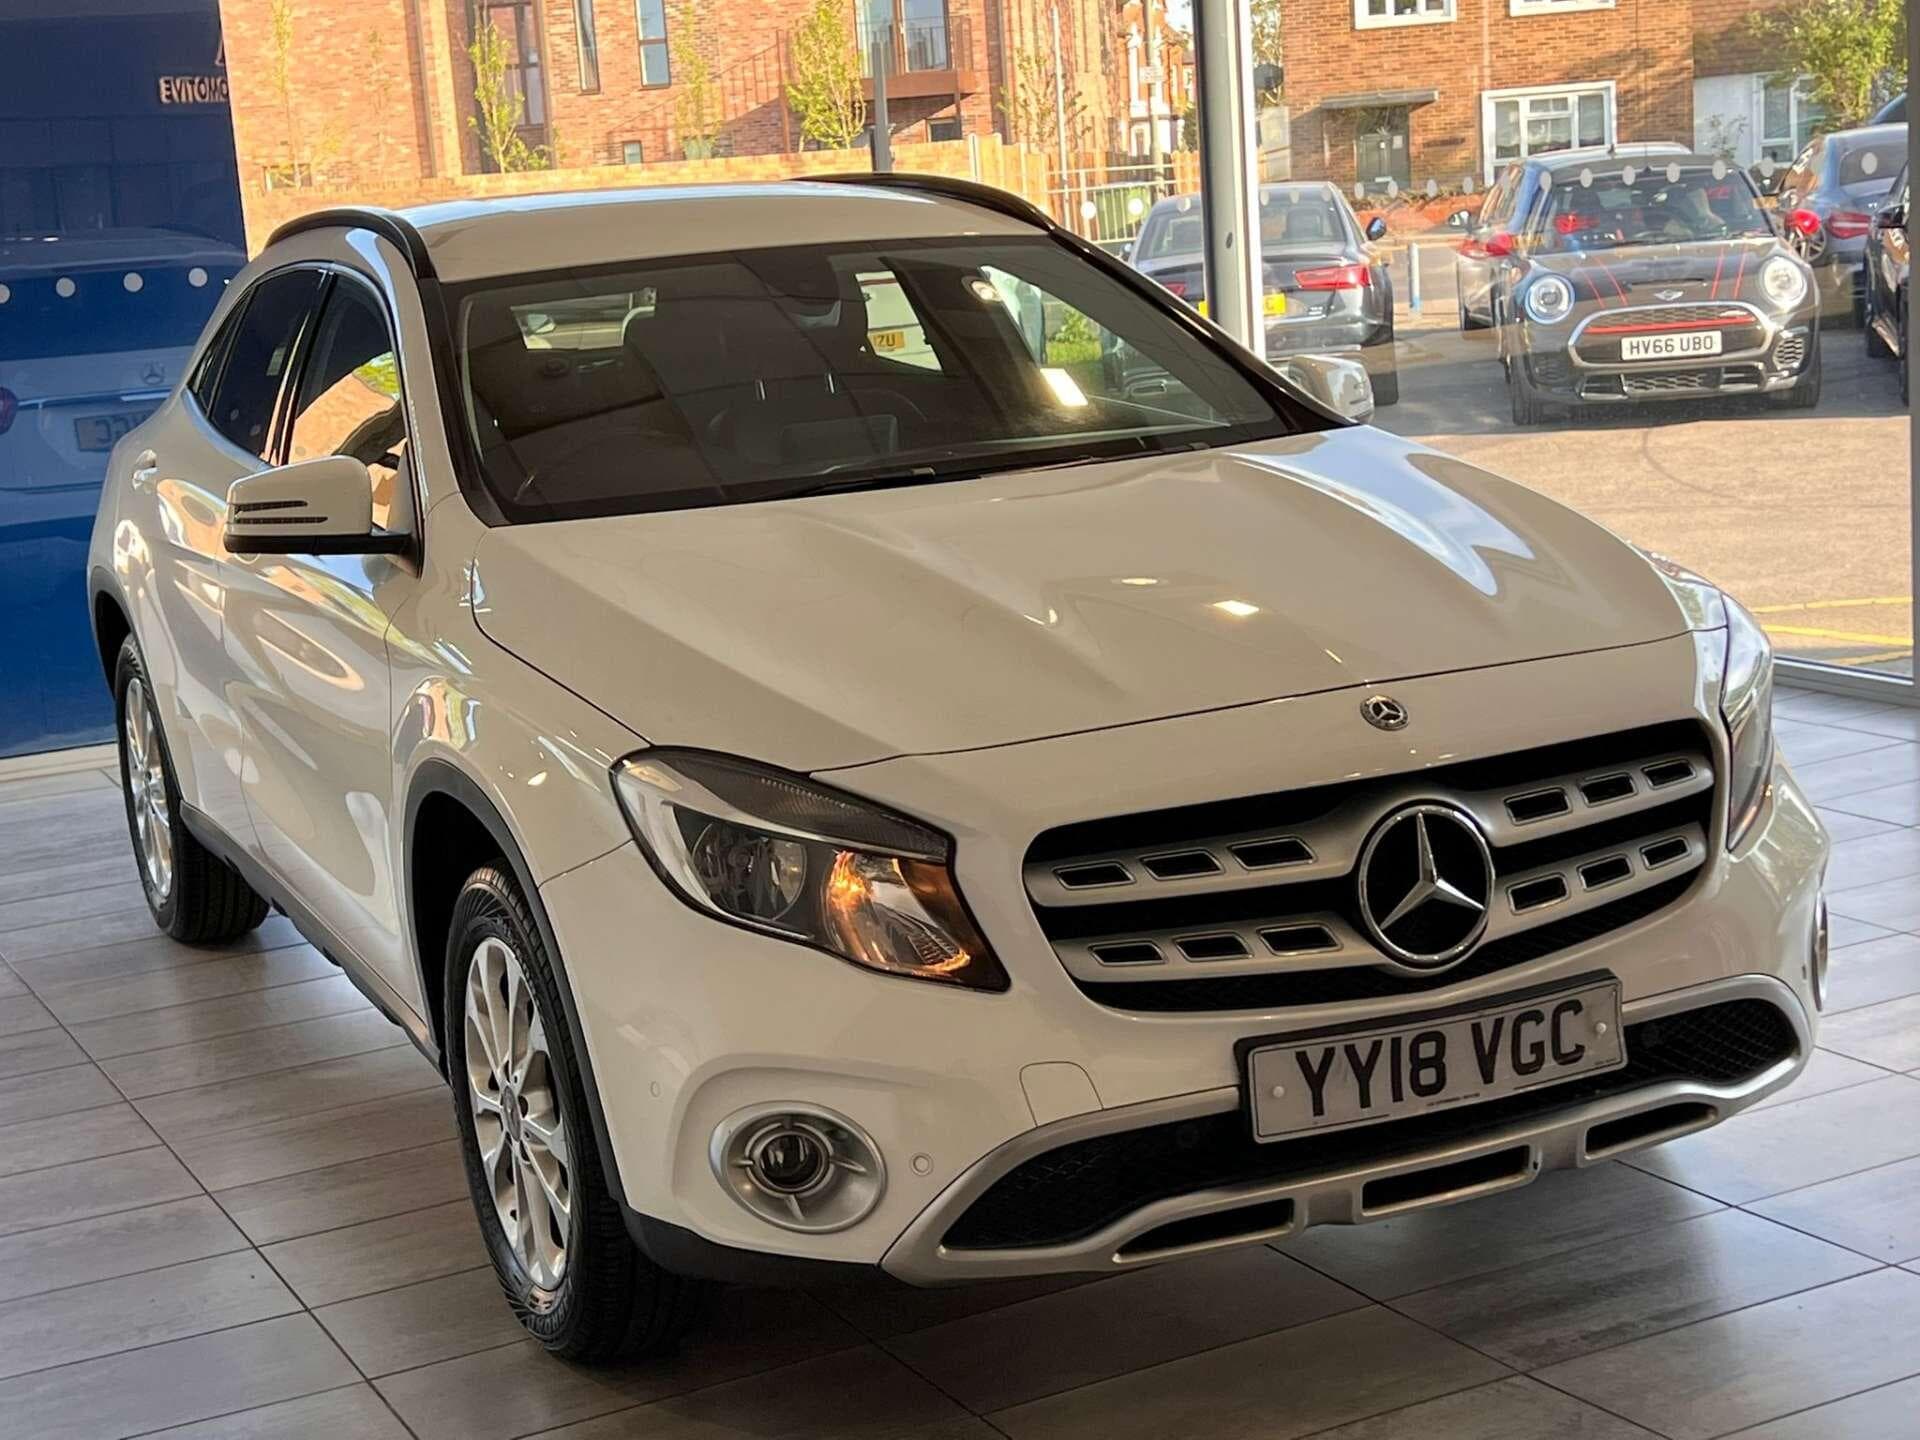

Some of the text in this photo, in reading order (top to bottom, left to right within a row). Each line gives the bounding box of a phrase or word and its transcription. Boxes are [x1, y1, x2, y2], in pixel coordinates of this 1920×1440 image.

[1629, 335, 1713, 356] HV66 UBO
[1295, 999, 1586, 1117] YY18 VGC
